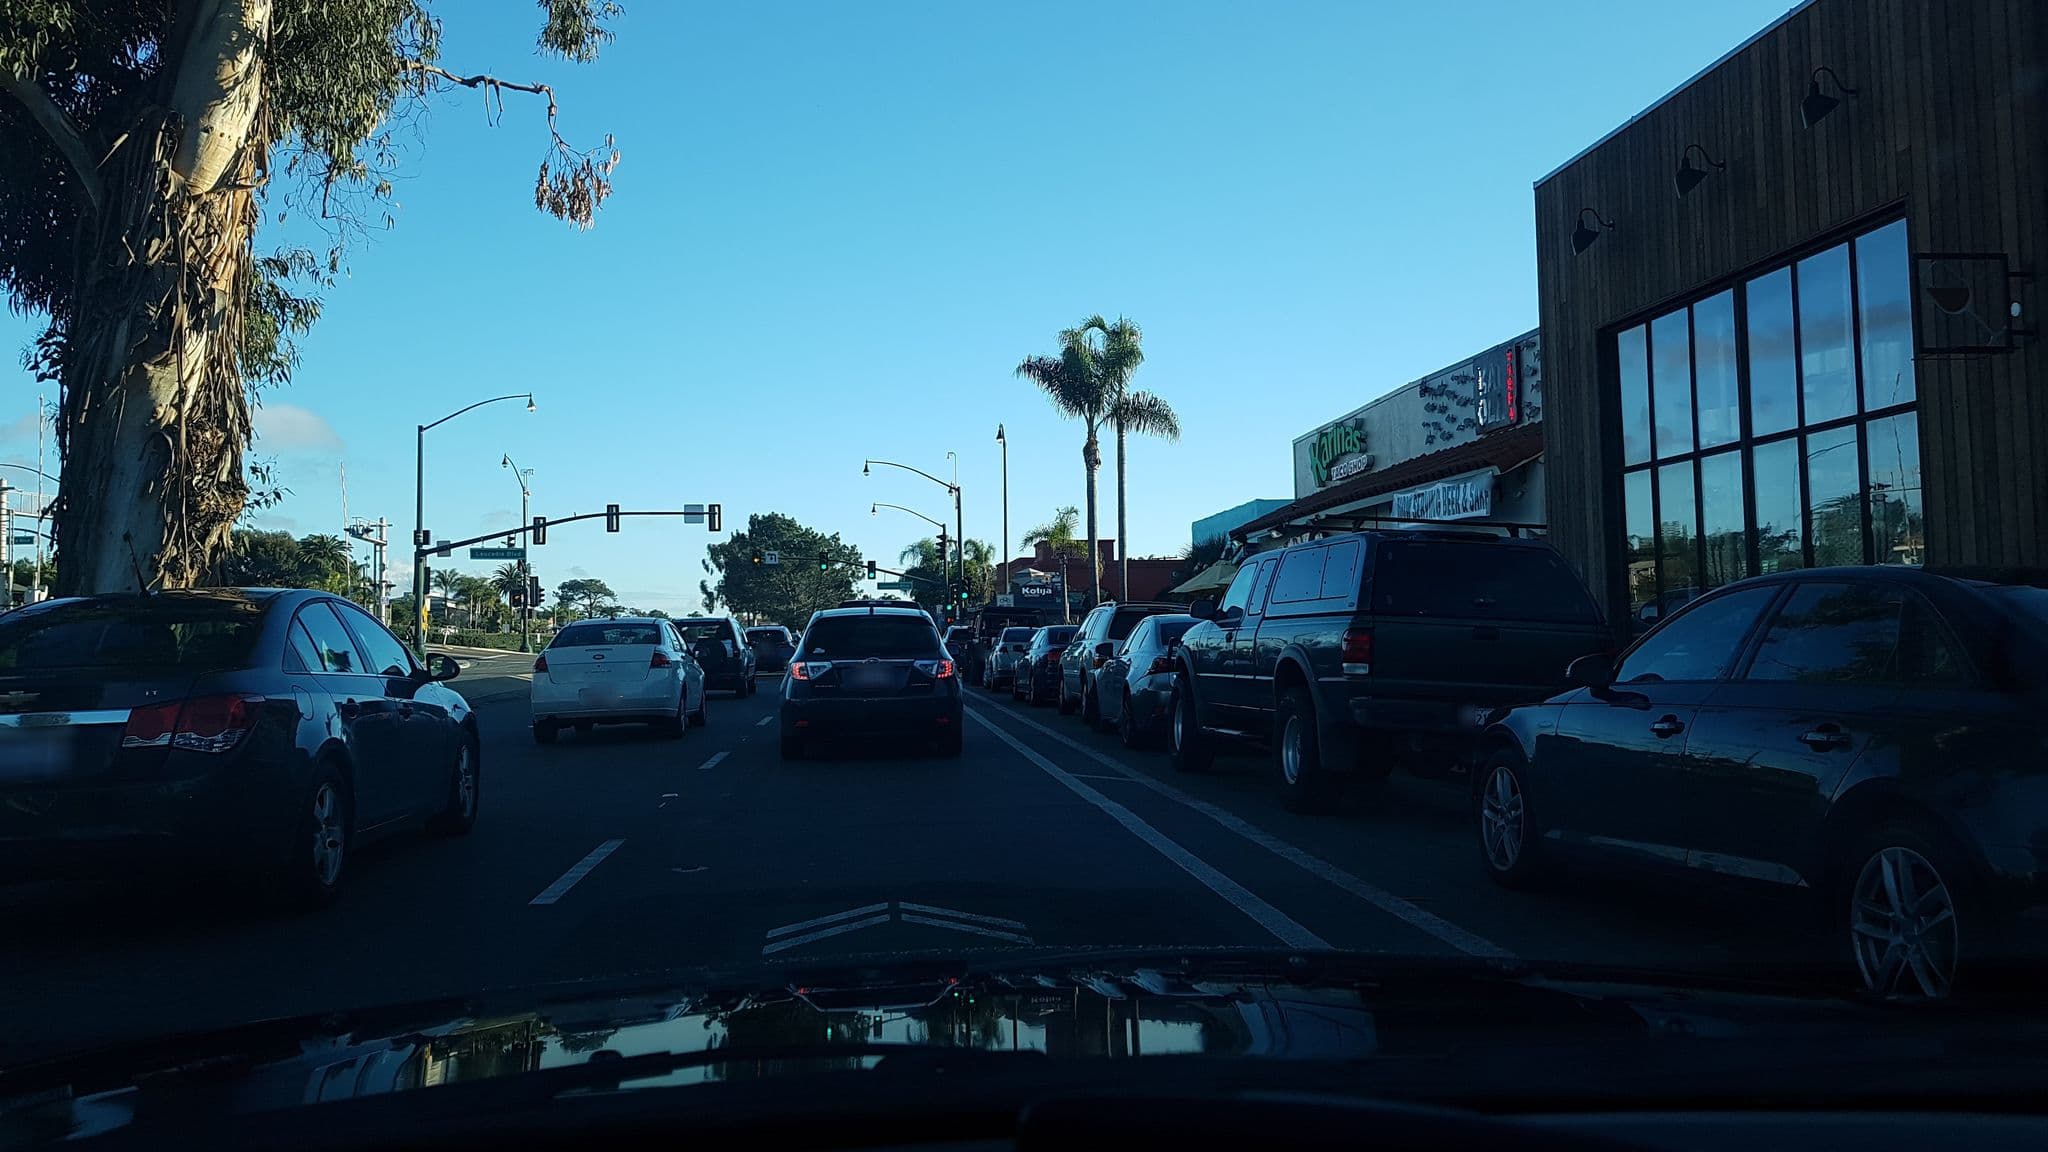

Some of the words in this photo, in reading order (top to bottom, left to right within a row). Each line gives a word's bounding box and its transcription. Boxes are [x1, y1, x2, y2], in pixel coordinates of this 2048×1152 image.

[1310, 419, 1362, 483] Karina's
[1330, 460, 1348, 480] TACO
[1347, 454, 1368, 473] SHOP
[1442, 484, 1461, 516] BEER
[1461, 482, 1469, 513] &
